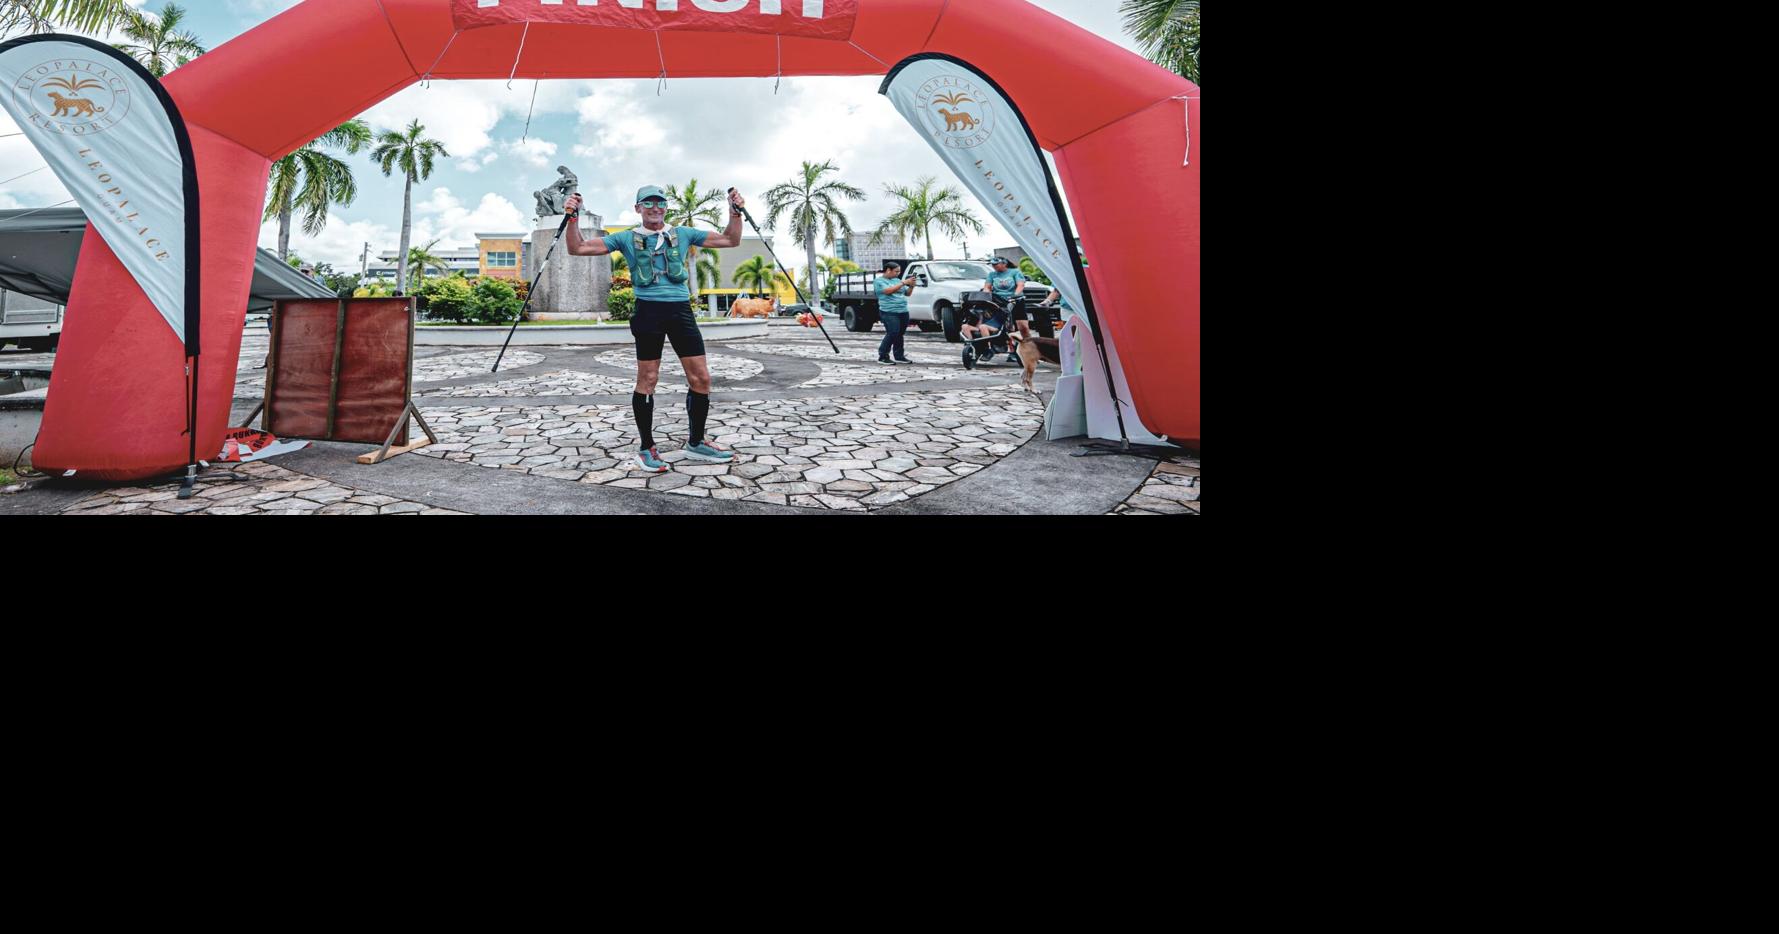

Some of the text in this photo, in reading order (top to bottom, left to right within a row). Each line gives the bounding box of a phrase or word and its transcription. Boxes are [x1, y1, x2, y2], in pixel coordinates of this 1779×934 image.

[18, 60, 128, 95] LEOPALACE
[28, 112, 113, 134] RESORT
[78, 148, 170, 263] LEOPALACE
[974, 159, 1061, 260] LEOPALACE
